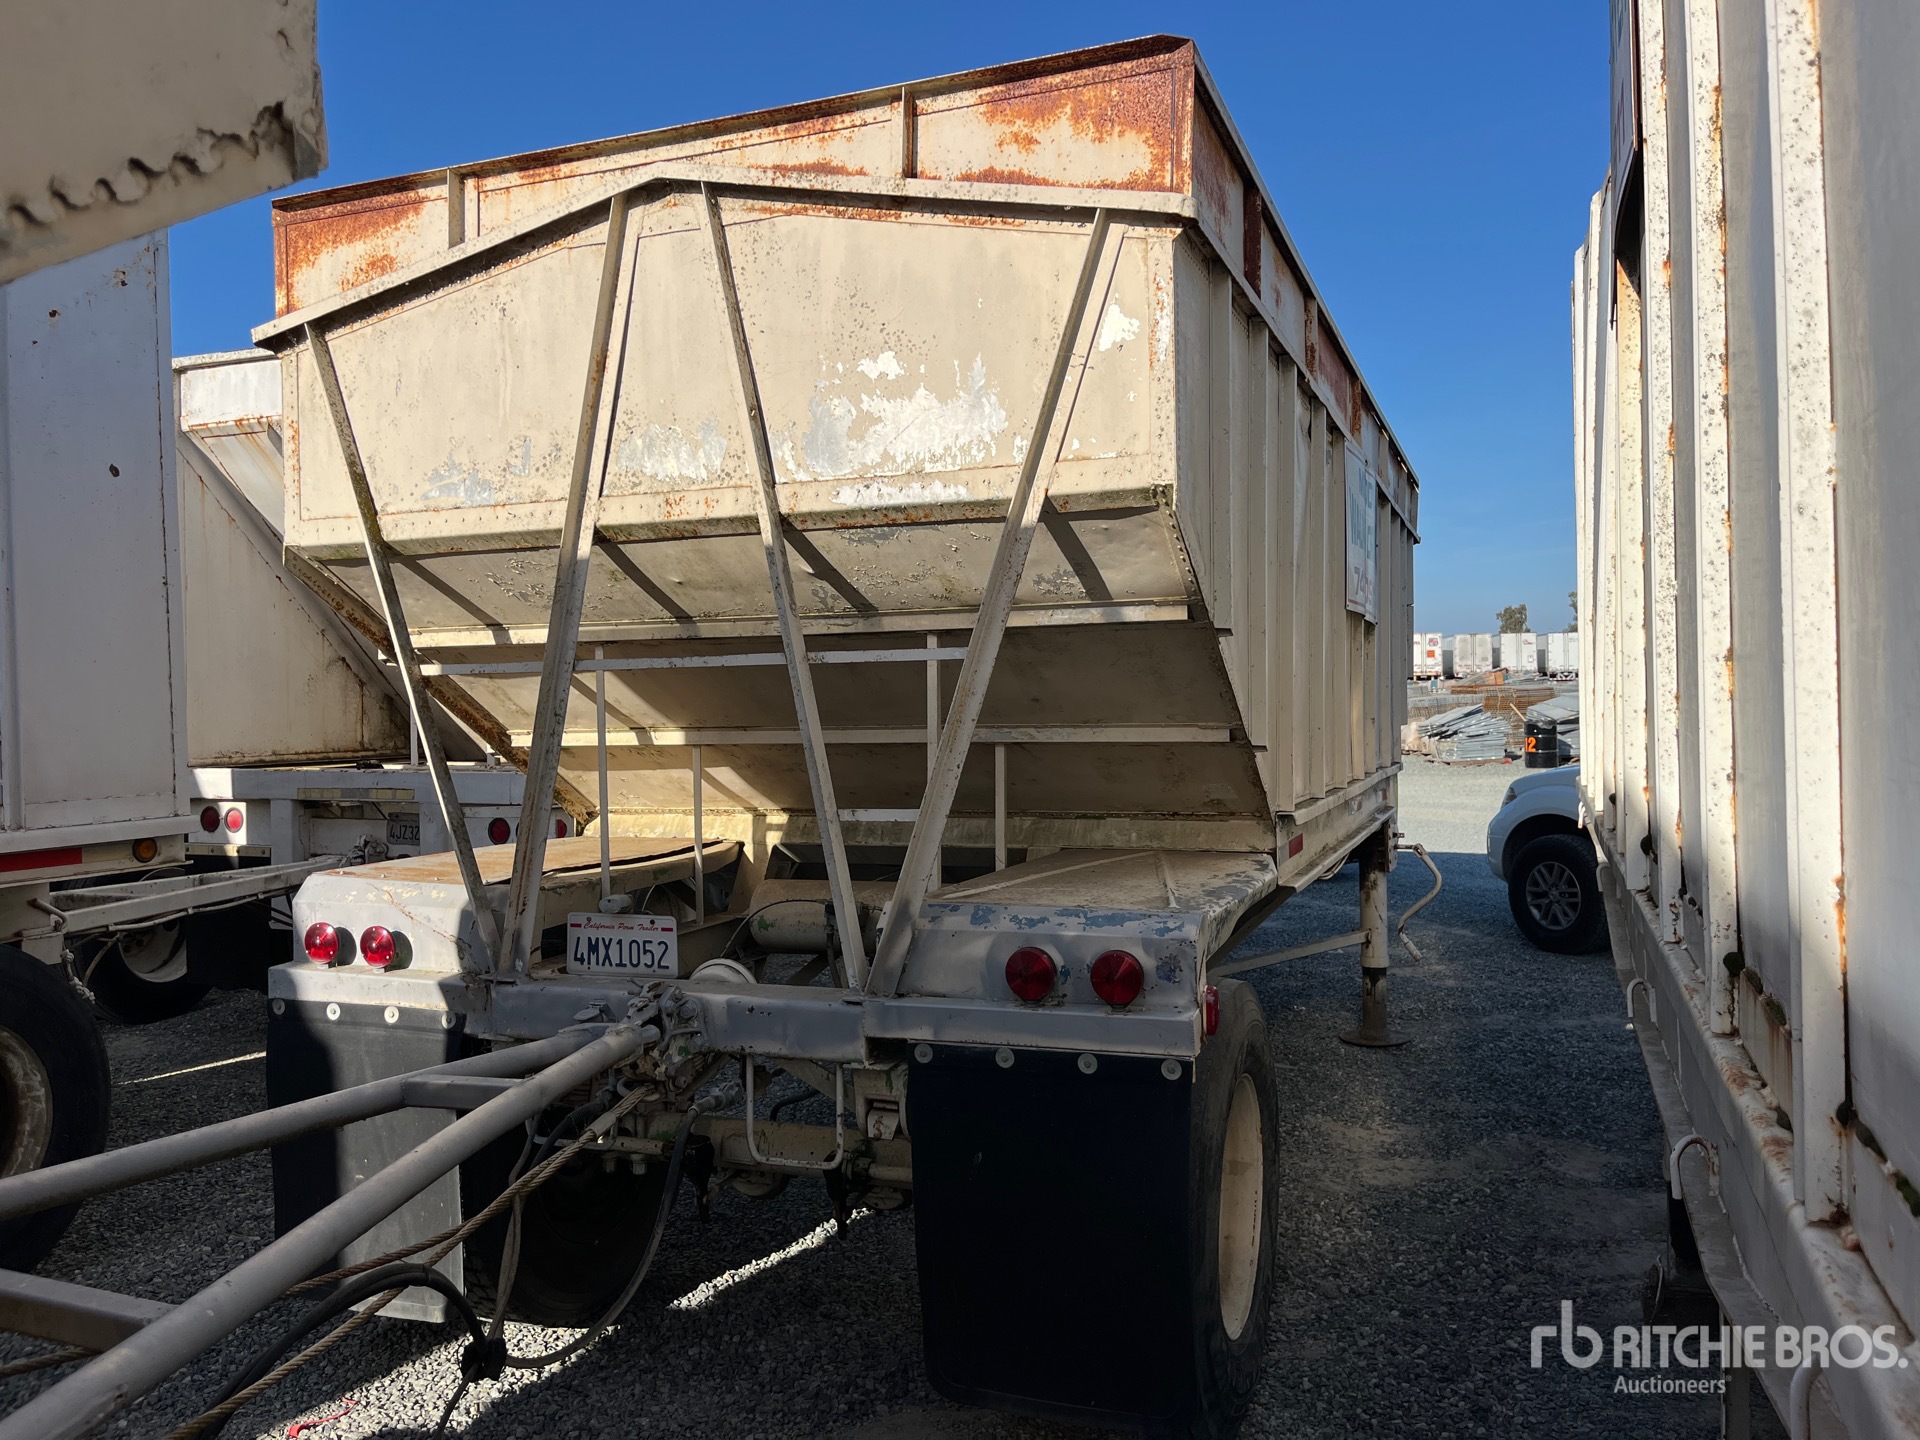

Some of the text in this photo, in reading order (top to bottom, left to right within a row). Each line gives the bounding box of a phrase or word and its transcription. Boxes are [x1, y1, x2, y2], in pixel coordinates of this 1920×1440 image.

[583, 922, 659, 932] California Perm Trailer
[573, 936, 670, 970] 4MX1052
